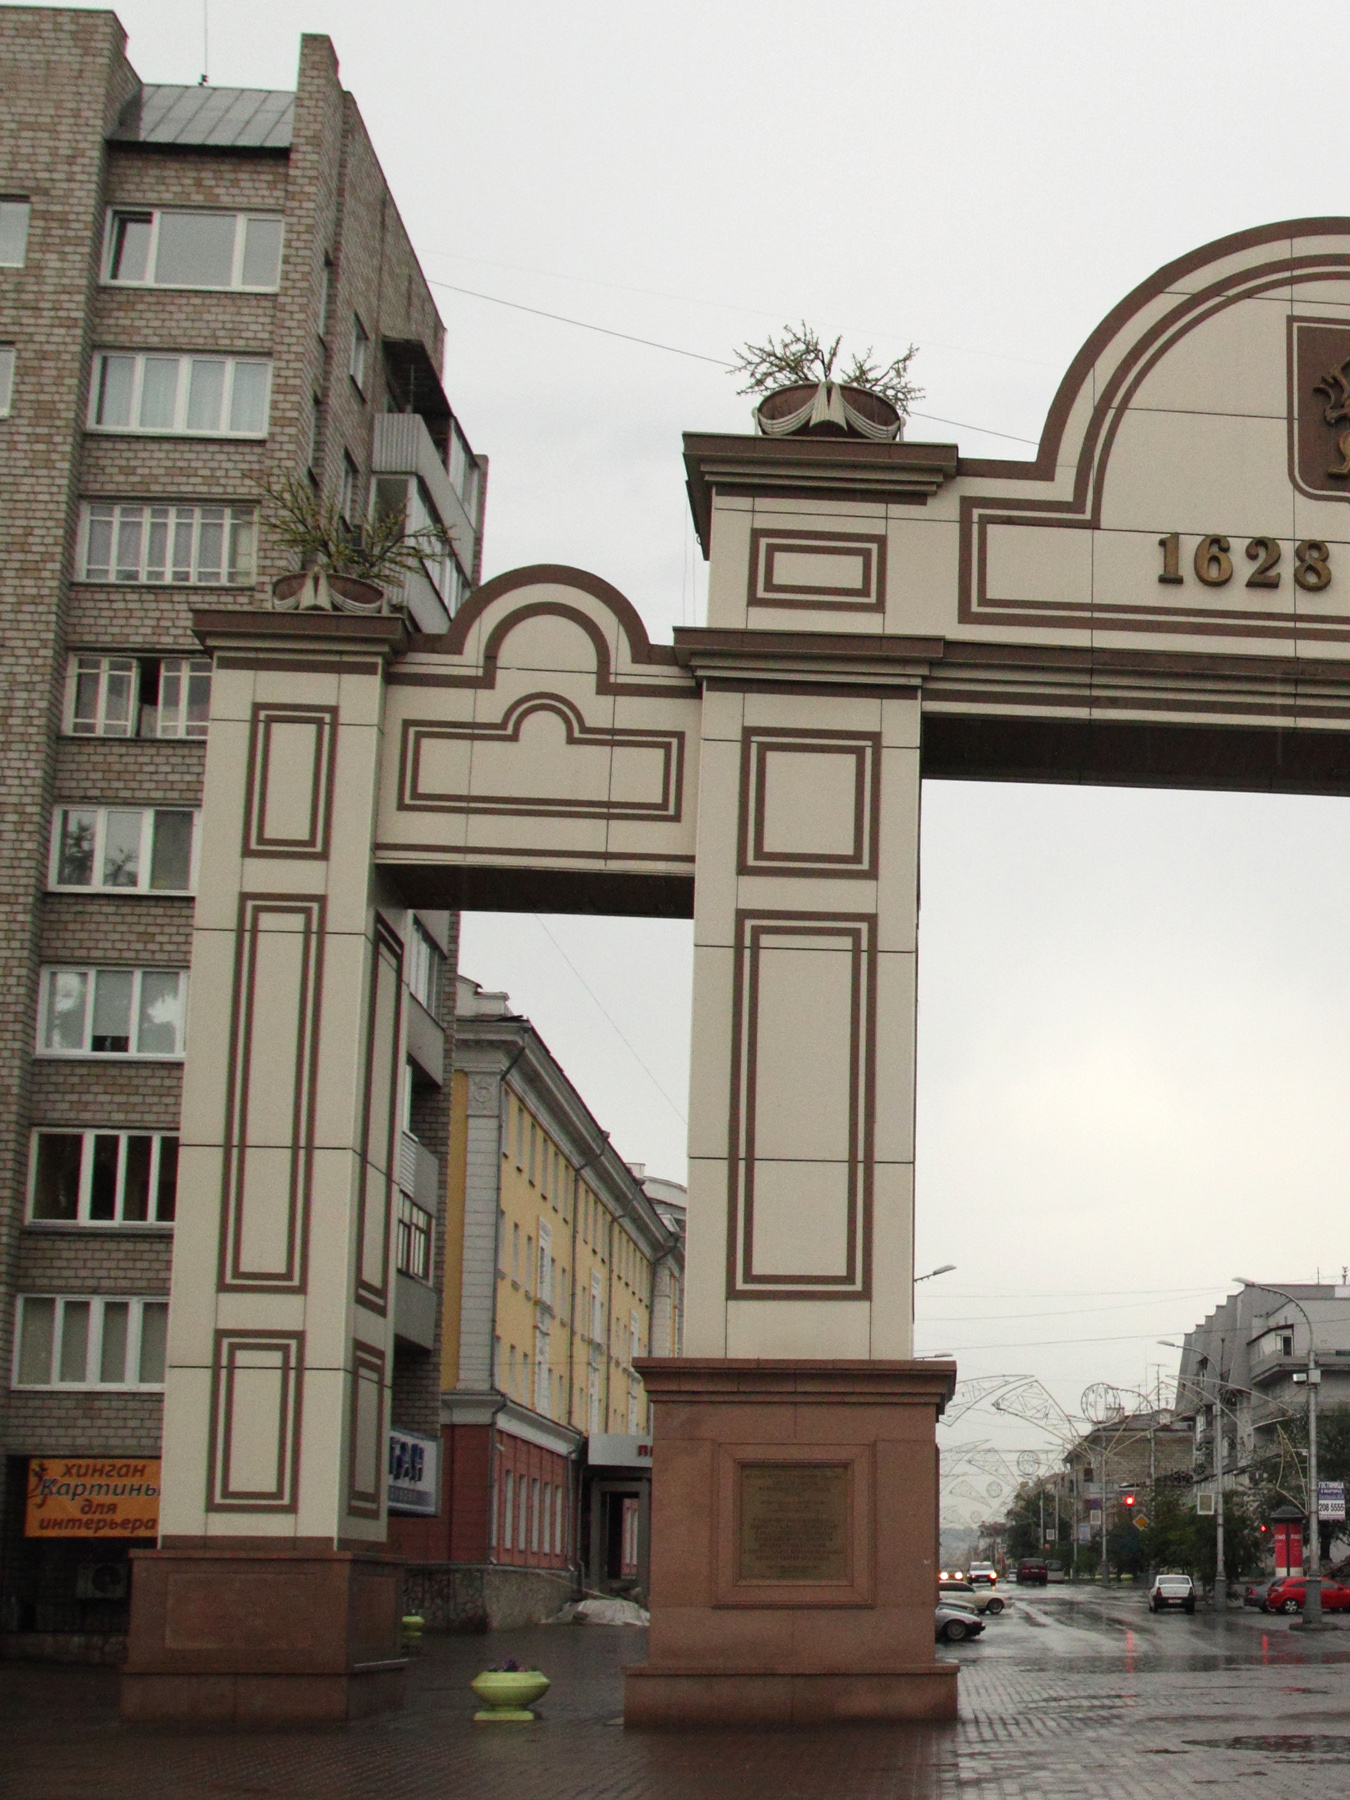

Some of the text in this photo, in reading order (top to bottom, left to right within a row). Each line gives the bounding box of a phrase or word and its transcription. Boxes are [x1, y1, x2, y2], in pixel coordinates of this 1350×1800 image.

[1158, 532, 1332, 591] 1628
[80, 1499, 118, 1515] для
[39, 1518, 157, 1534] интерьера
